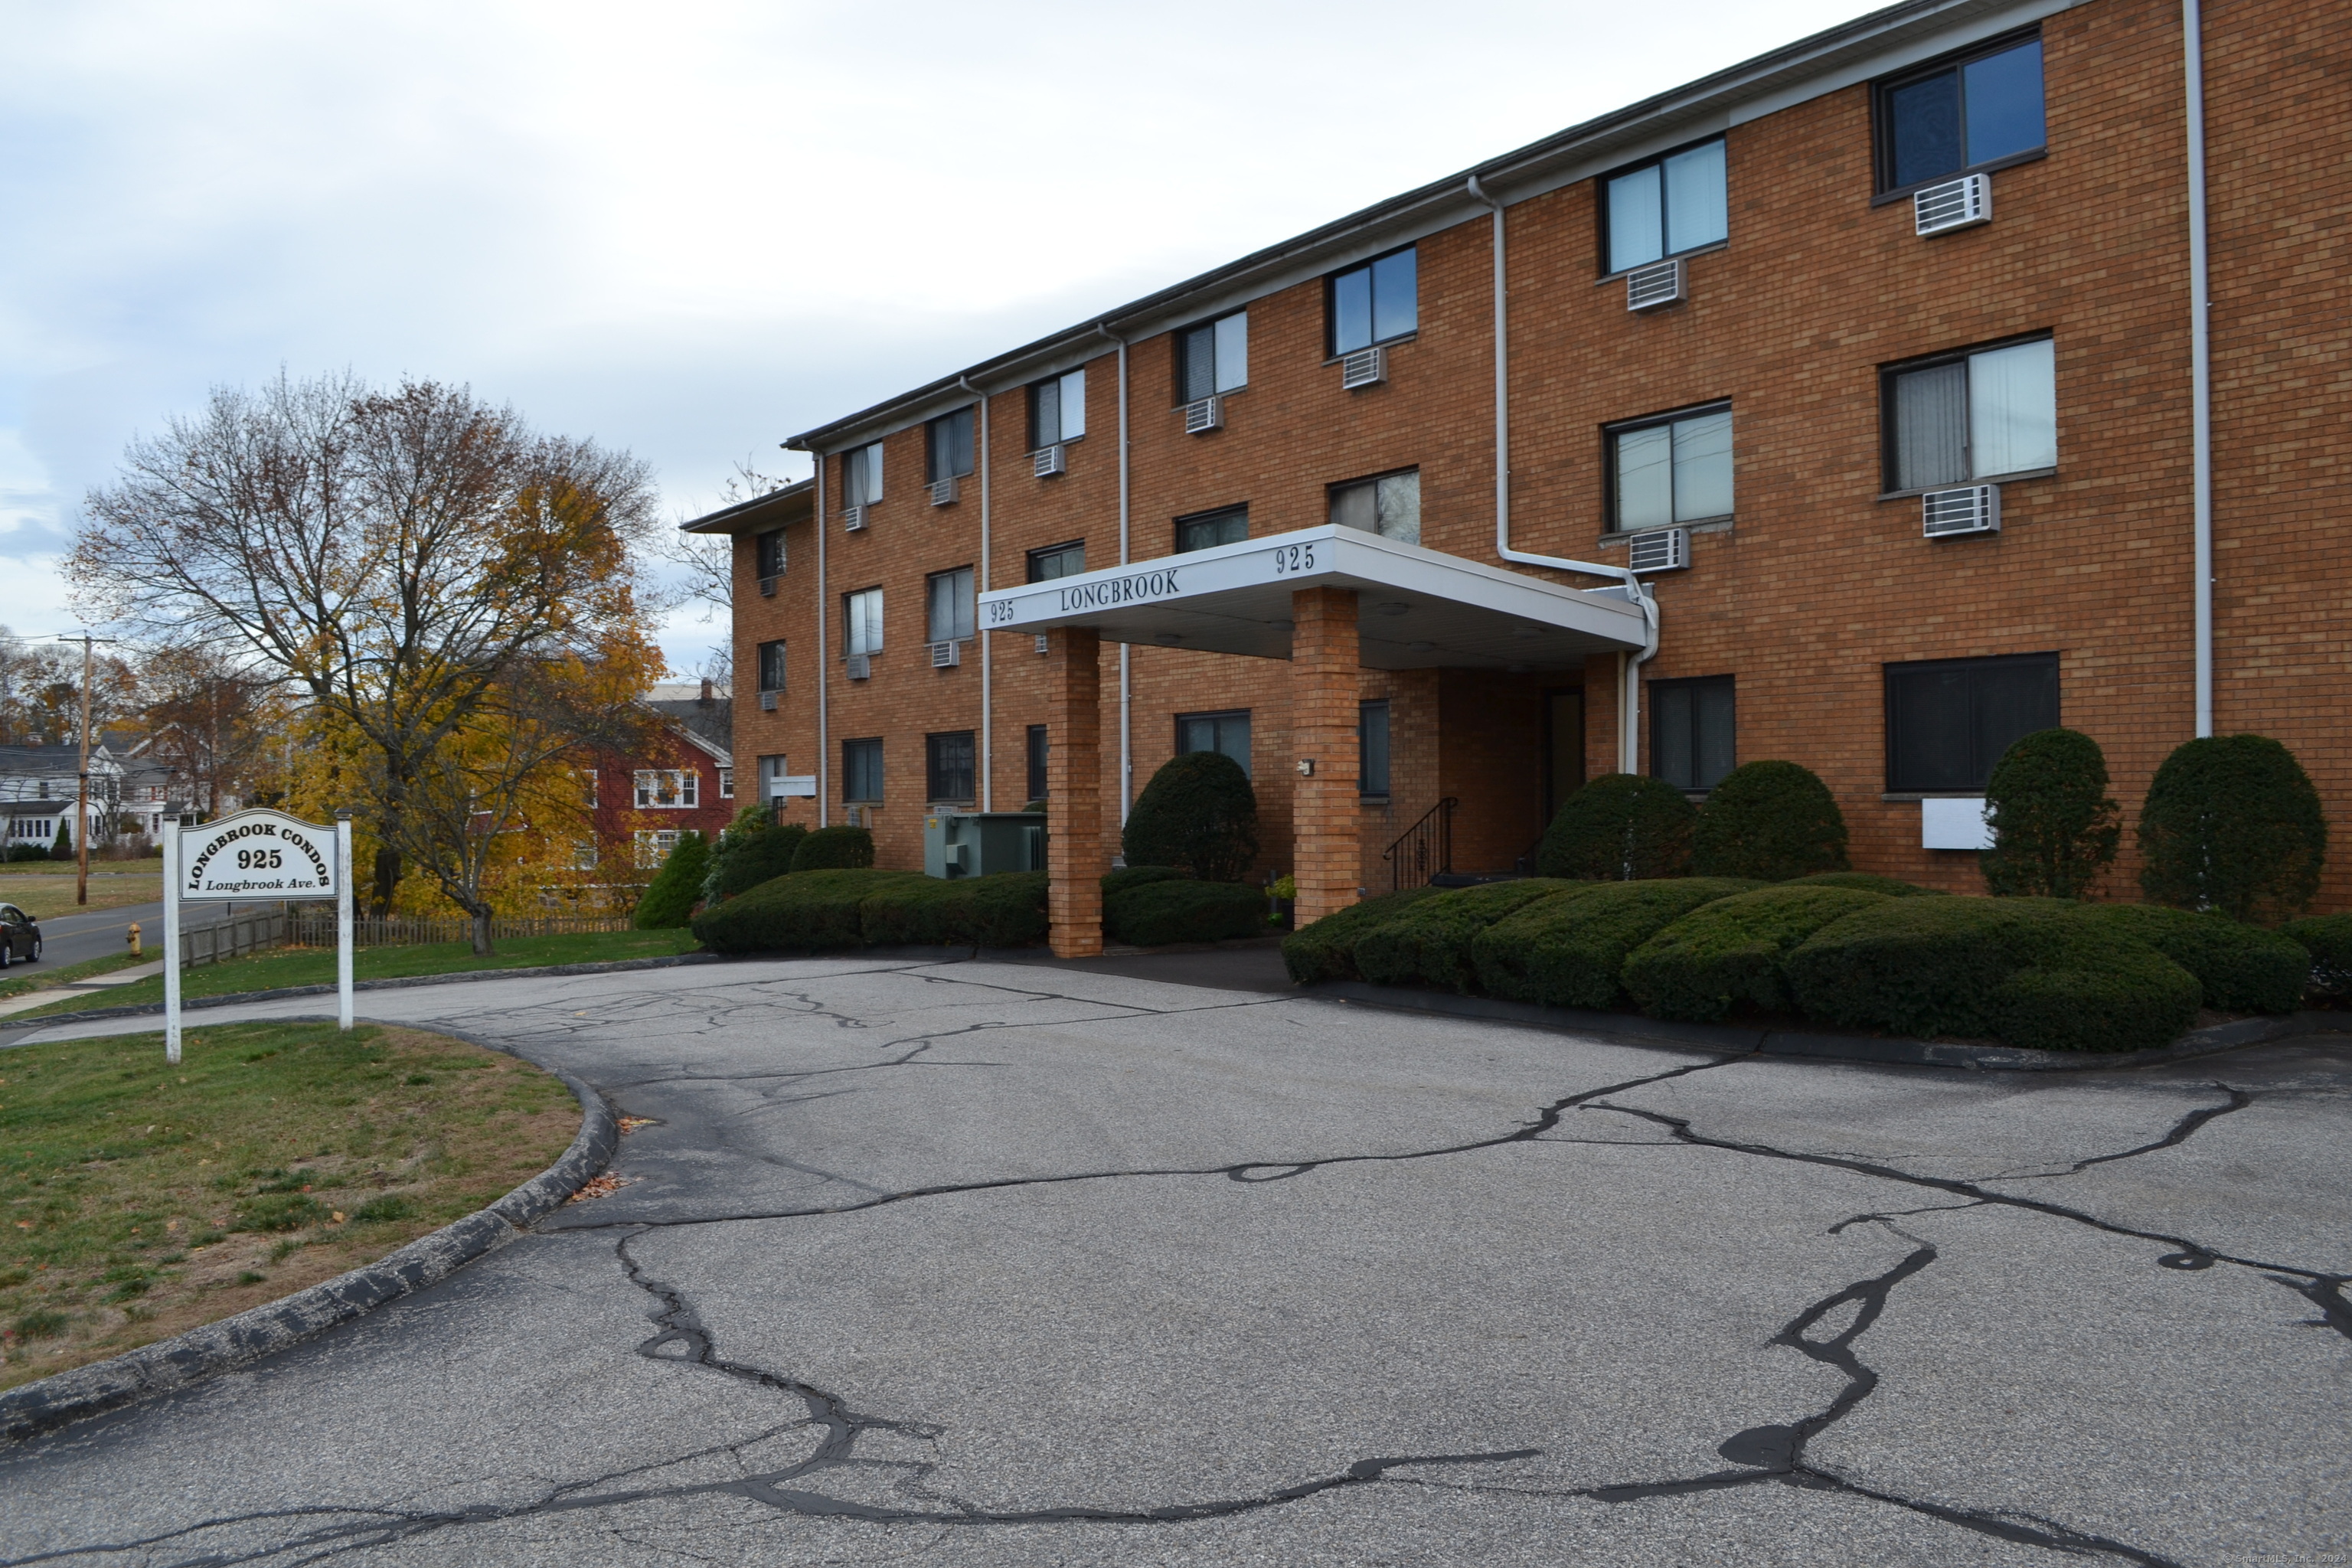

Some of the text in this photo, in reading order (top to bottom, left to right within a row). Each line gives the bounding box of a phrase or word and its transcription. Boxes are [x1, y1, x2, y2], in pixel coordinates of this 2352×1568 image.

[990, 544, 1315, 623] 925 LONGBROOK 925
[188, 824, 330, 890] LONGBROOK CONDOS
[237, 849, 283, 869] 925
[205, 878, 316, 893] Longbrook Ave.
